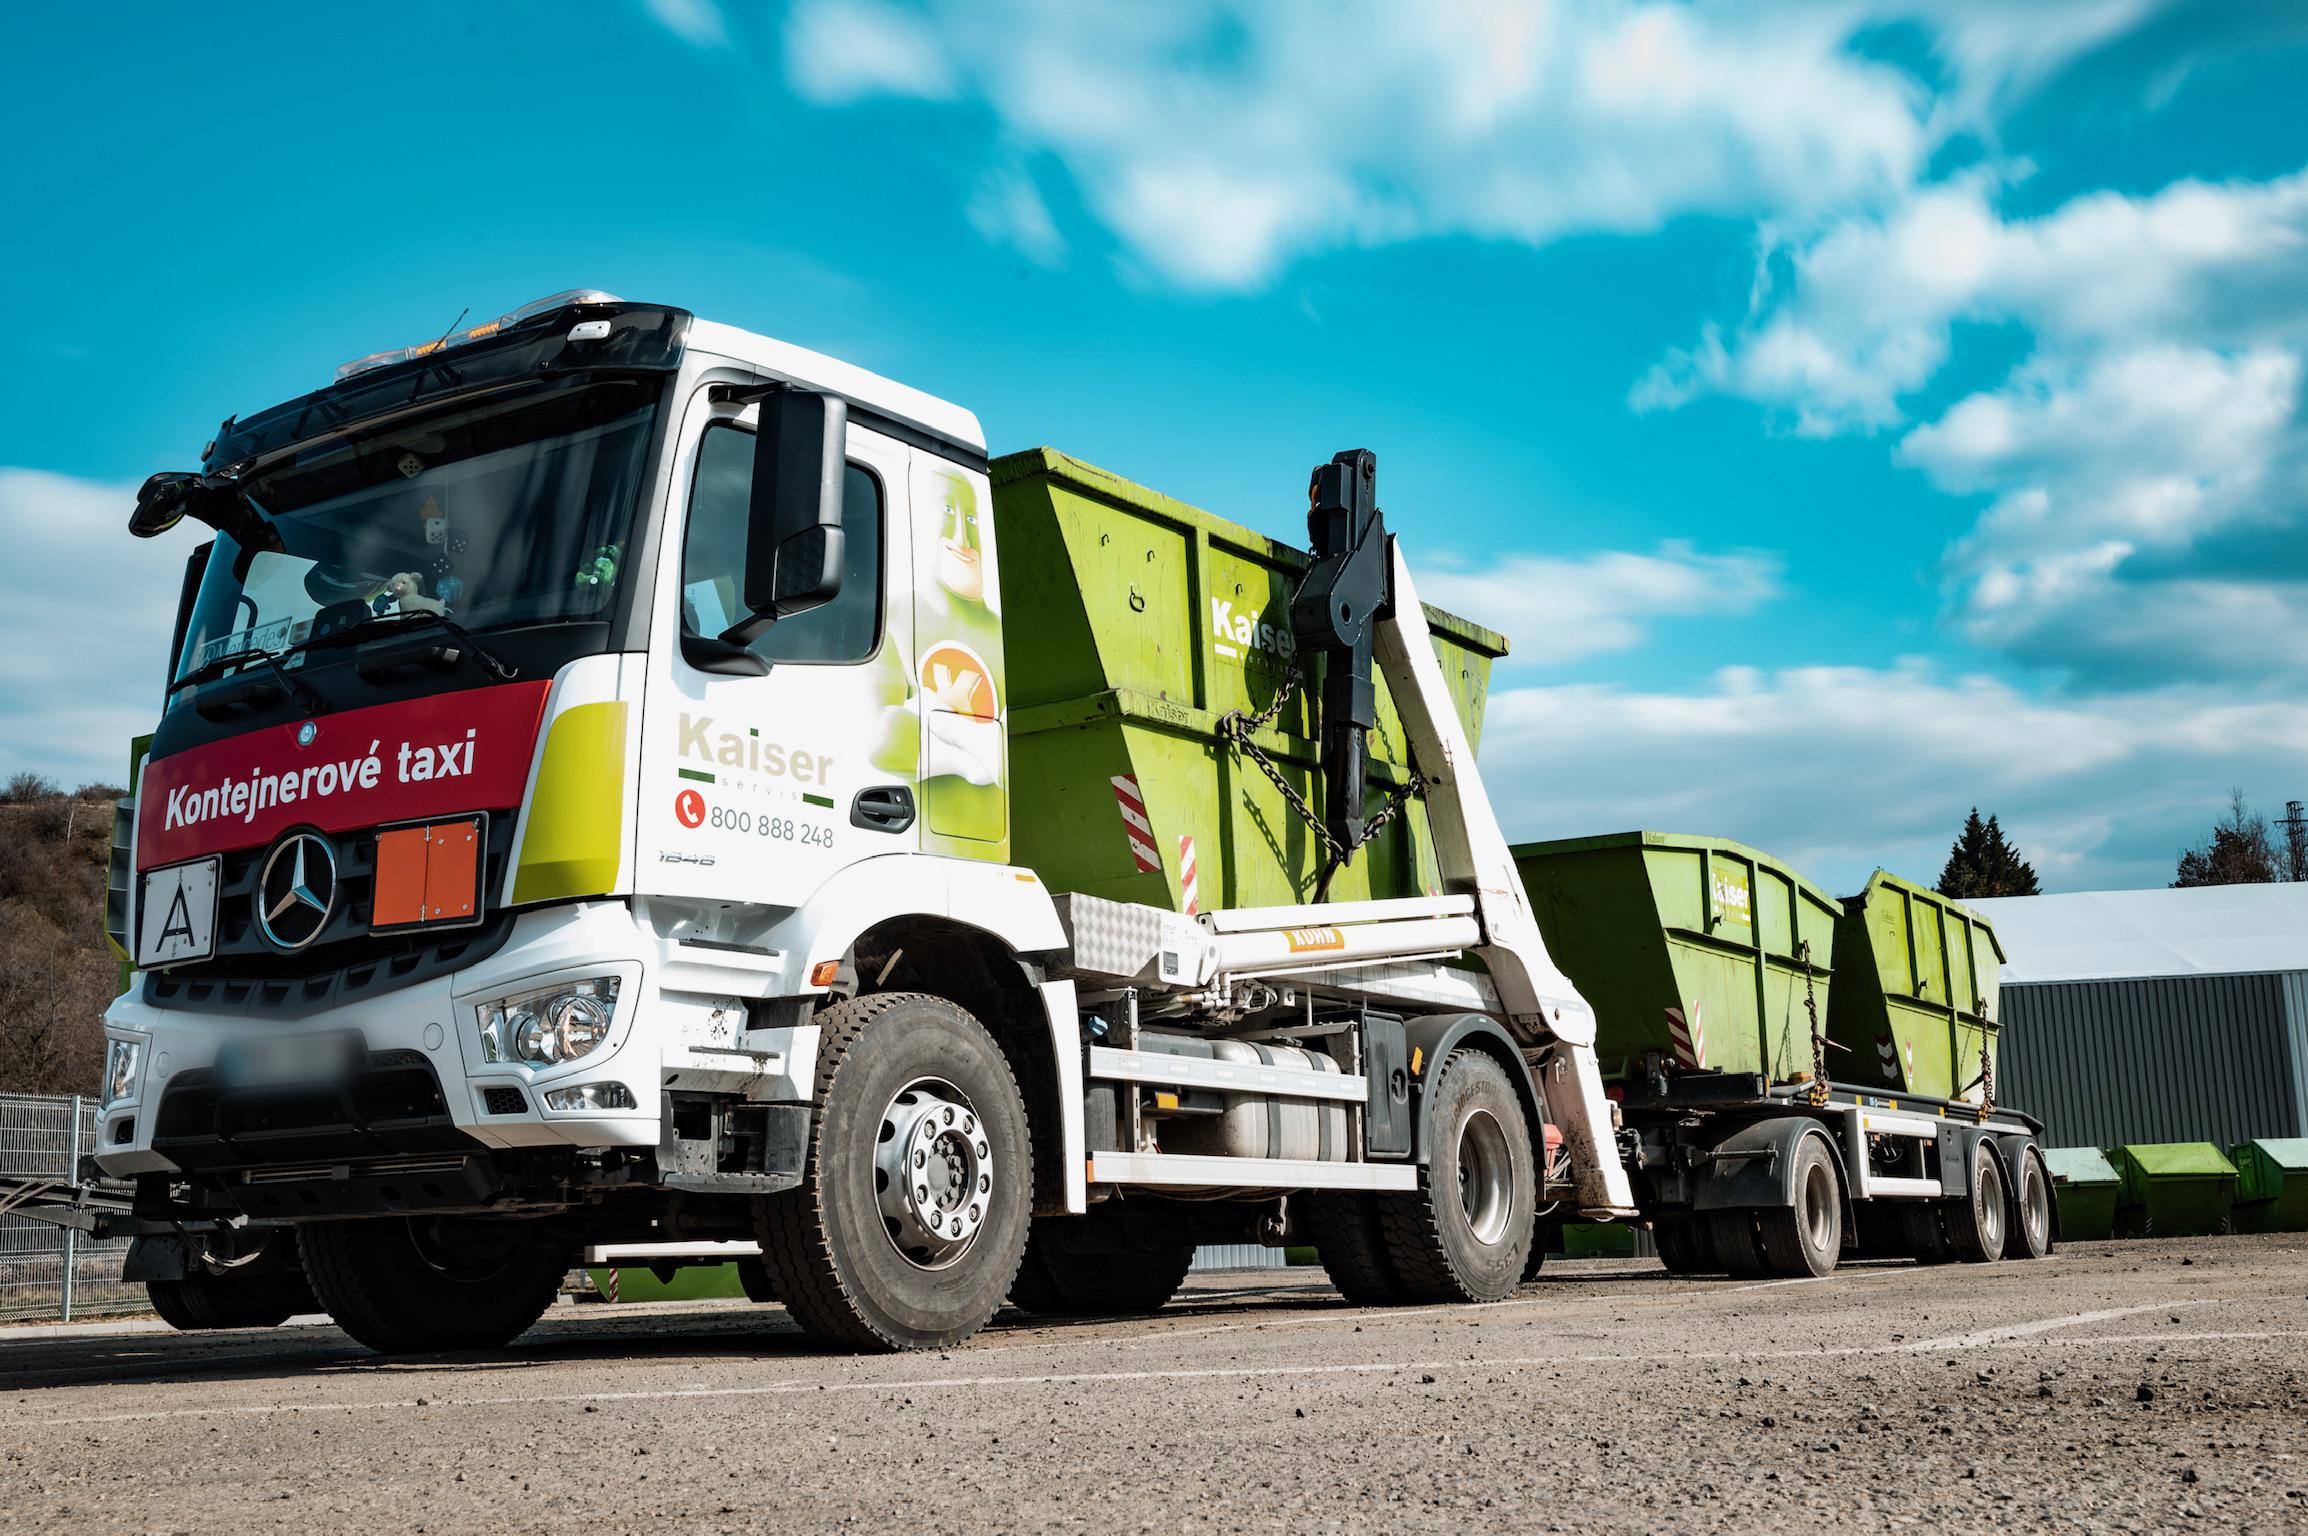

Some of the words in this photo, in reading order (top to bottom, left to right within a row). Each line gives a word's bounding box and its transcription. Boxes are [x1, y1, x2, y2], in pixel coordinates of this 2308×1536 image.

[1211, 596, 1297, 660] Kaise
[164, 739, 382, 832] Kontejnerové
[397, 728, 477, 783] taxi
[677, 711, 835, 787] Kaiser
[711, 806, 751, 833] 800
[758, 815, 795, 841] 888
[800, 823, 834, 849] 248
[155, 882, 195, 953] A
